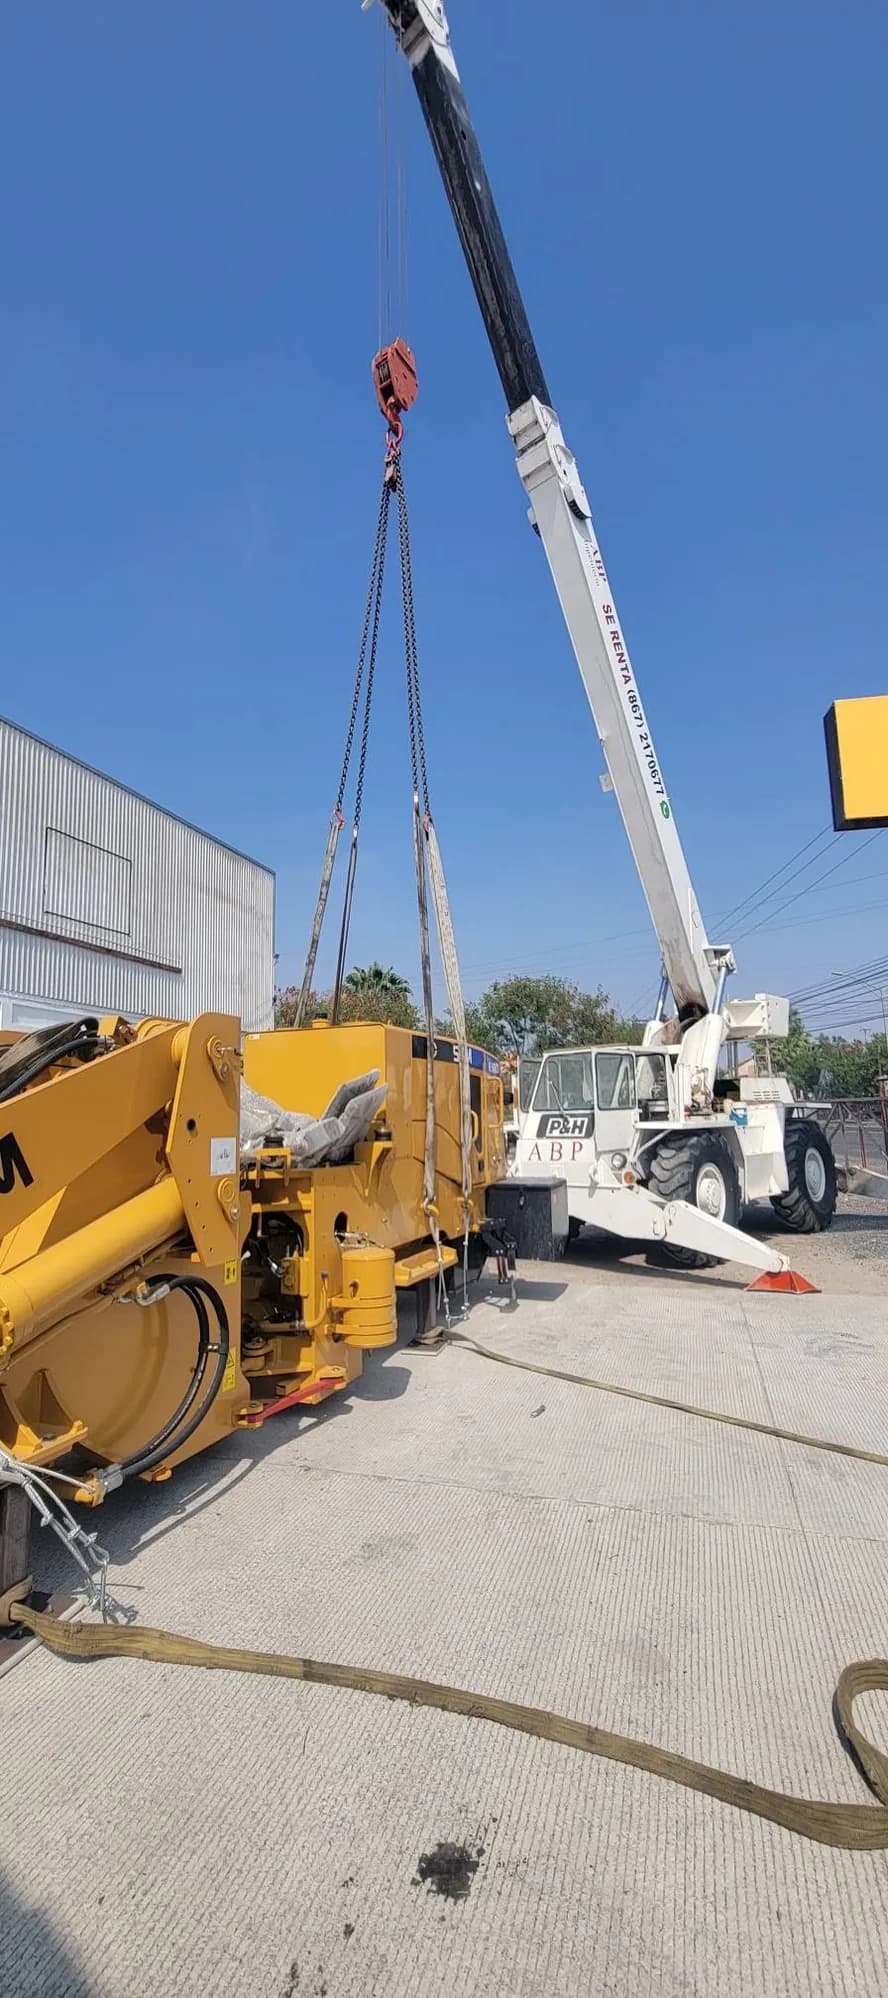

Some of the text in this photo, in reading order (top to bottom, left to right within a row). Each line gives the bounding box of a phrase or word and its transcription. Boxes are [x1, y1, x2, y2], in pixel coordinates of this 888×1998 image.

[602, 604, 664, 795] SE RENTA (867) 2170677
[548, 1118, 586, 1135] P&H
